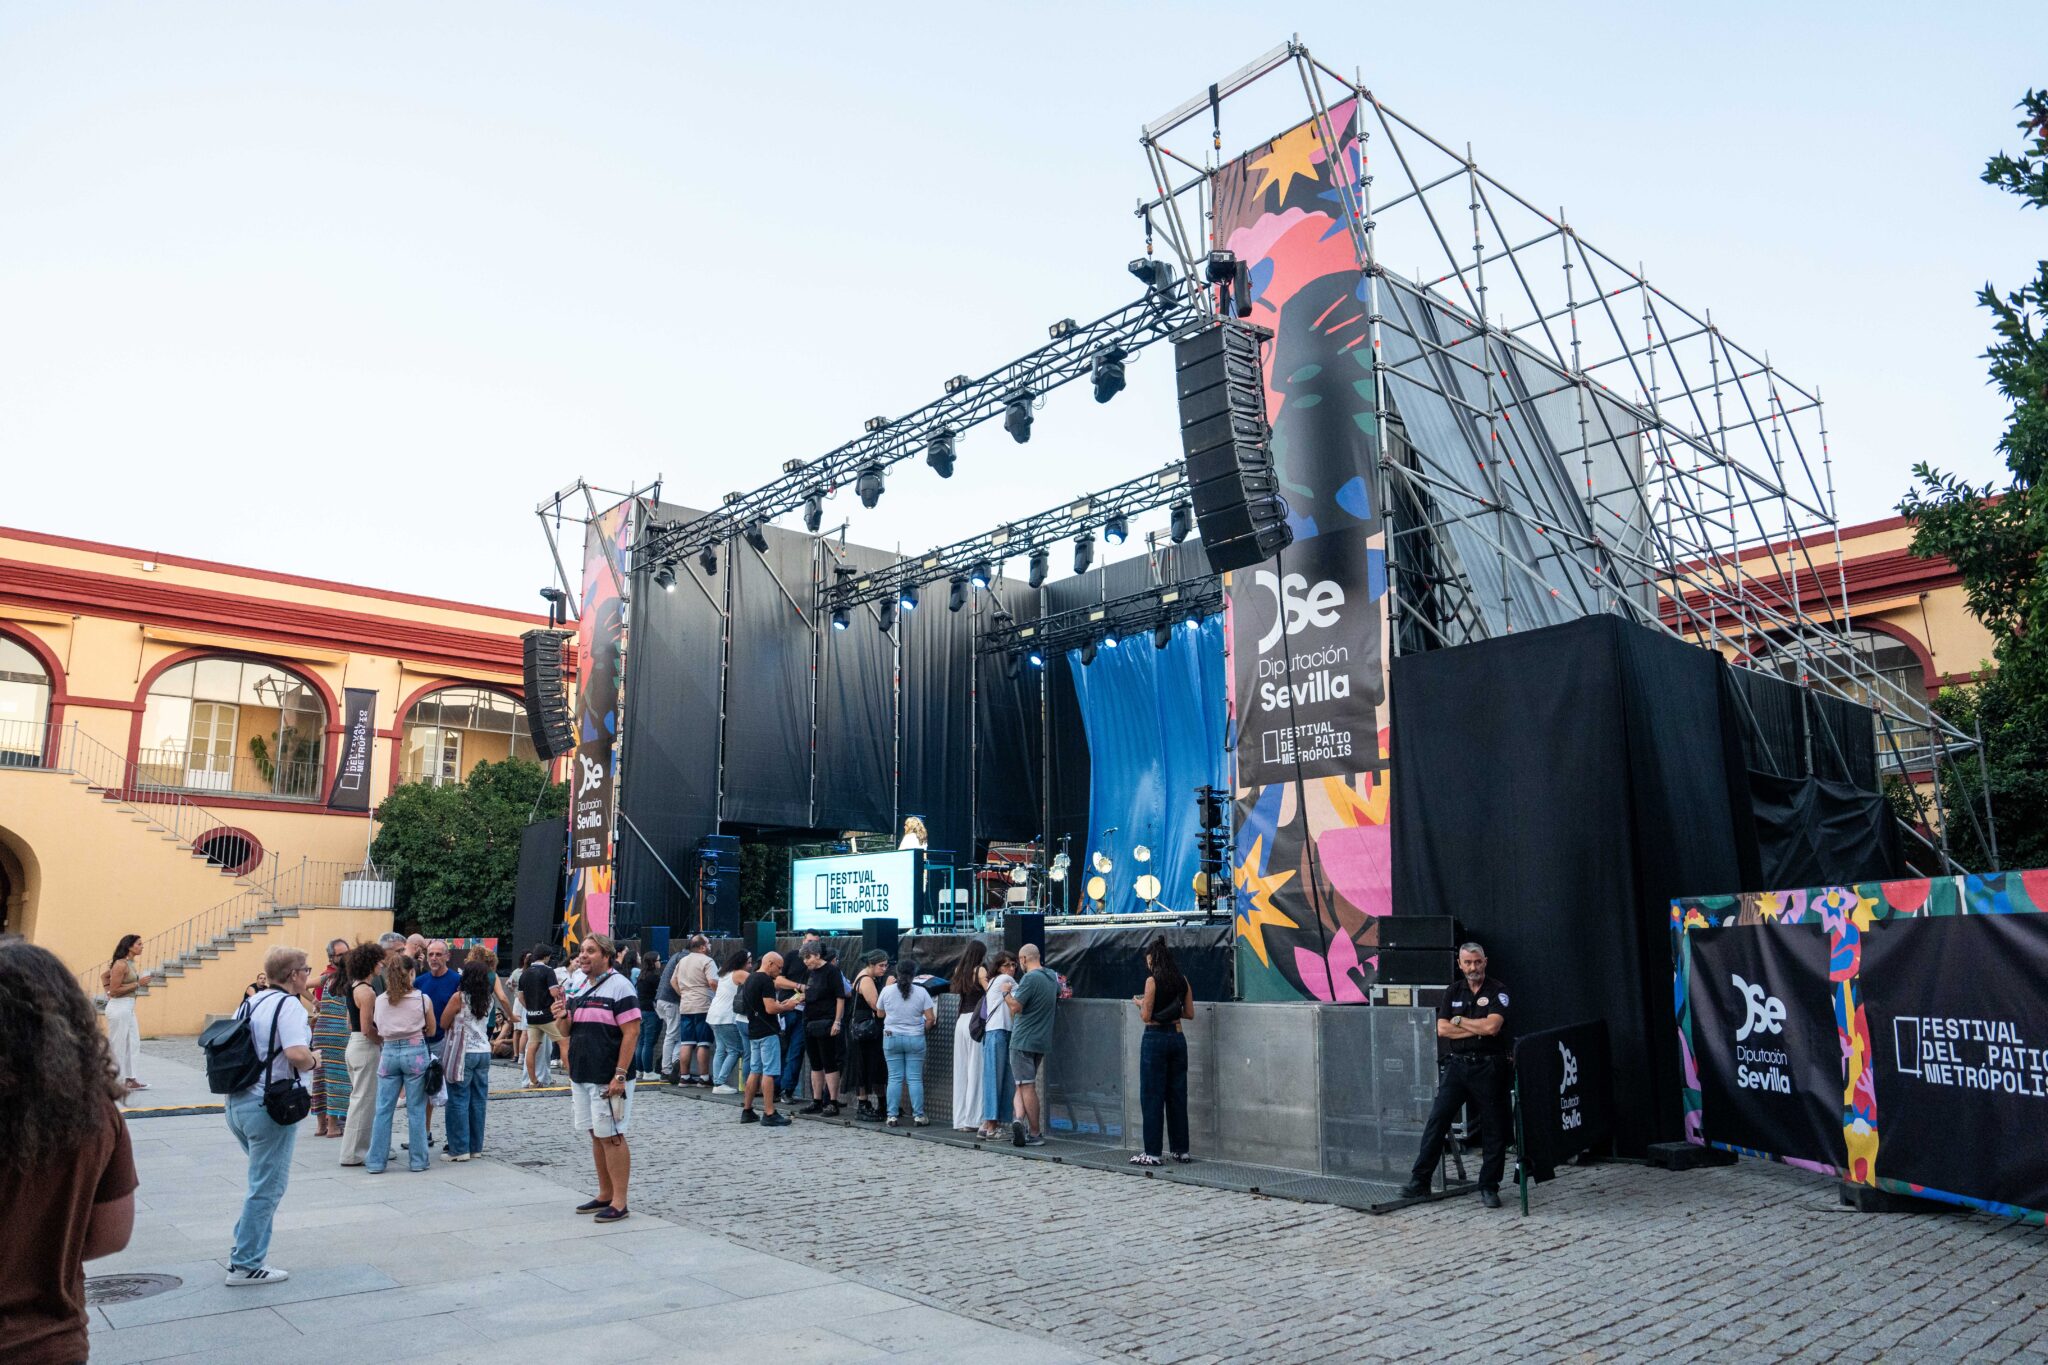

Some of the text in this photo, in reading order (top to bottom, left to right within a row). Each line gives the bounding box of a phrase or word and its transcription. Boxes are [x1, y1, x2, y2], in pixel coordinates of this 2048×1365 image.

[1258, 644, 1349, 680] Diputación
[1260, 669, 1350, 712] Sevilla
[1280, 720, 1335, 740] FESTIVAL
[1315, 731, 1351, 748] PATIO
[577, 811, 601, 830] Sevilla
[830, 869, 876, 886] FESTIVAL
[830, 883, 889, 900] DEL PATIO
[830, 896, 889, 914] METRÓPOLIS
[1922, 1017, 2024, 1044] FESTIVAL
[1736, 1045, 1788, 1065] Diputación
[1922, 1040, 1962, 1063] DEL
[1737, 1064, 1791, 1094] Sevilla
[1924, 1062, 2048, 1097] METRÓPOLI
[1562, 1109, 1581, 1130] Sevilla
